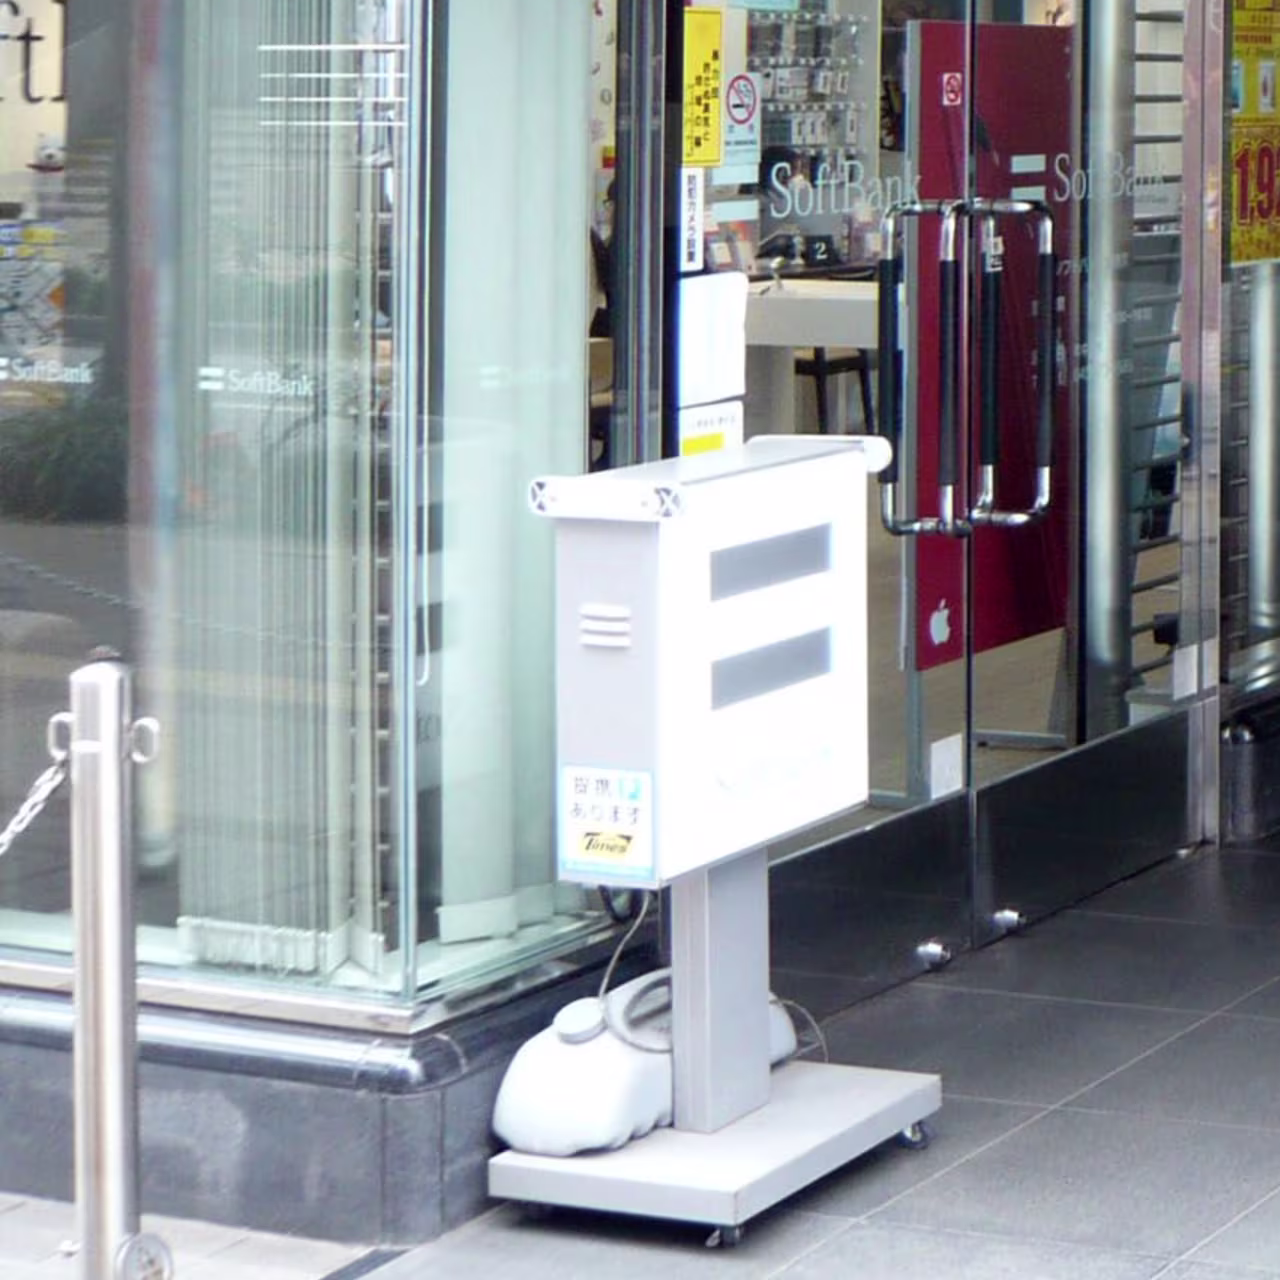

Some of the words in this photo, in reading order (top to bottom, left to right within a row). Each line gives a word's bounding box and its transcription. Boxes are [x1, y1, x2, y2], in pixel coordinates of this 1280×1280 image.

[770, 160, 923, 219] SoftBank
[815, 241, 828, 260] 2
[11, 360, 95, 384] SoftBank
[227, 371, 316, 397] SoftBank
